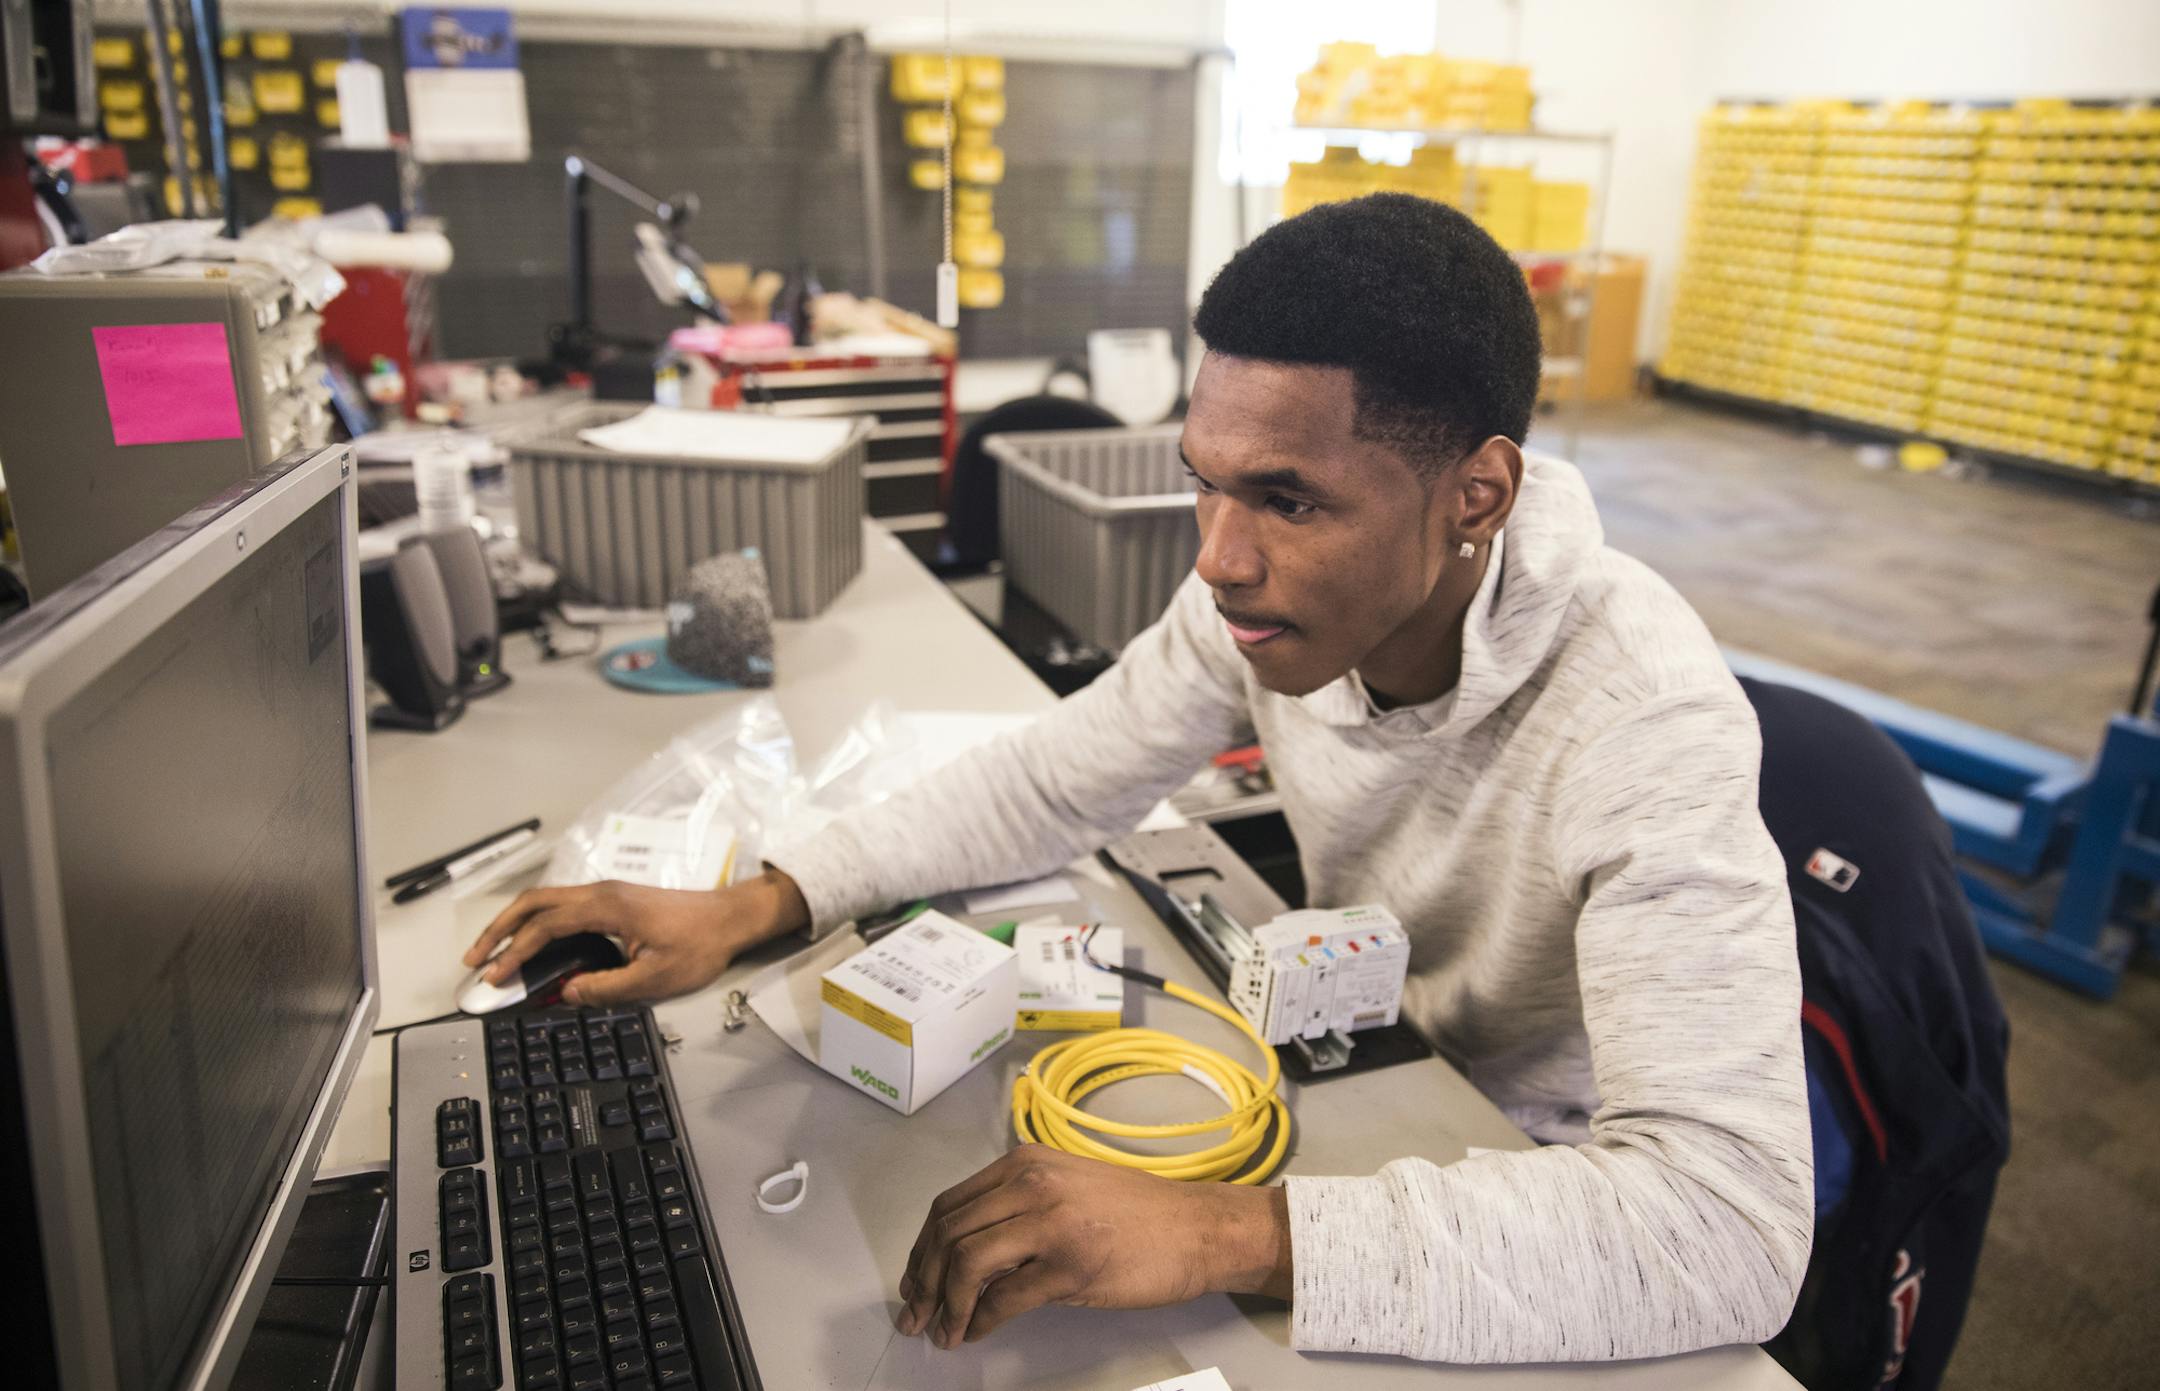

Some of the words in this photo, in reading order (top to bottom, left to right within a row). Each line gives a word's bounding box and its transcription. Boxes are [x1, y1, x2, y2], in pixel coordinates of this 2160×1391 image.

[851, 1065, 899, 1100] WAGO
[655, 1340, 668, 1349] B
[616, 1361, 629, 1371] G
[662, 1368, 674, 1378] V
